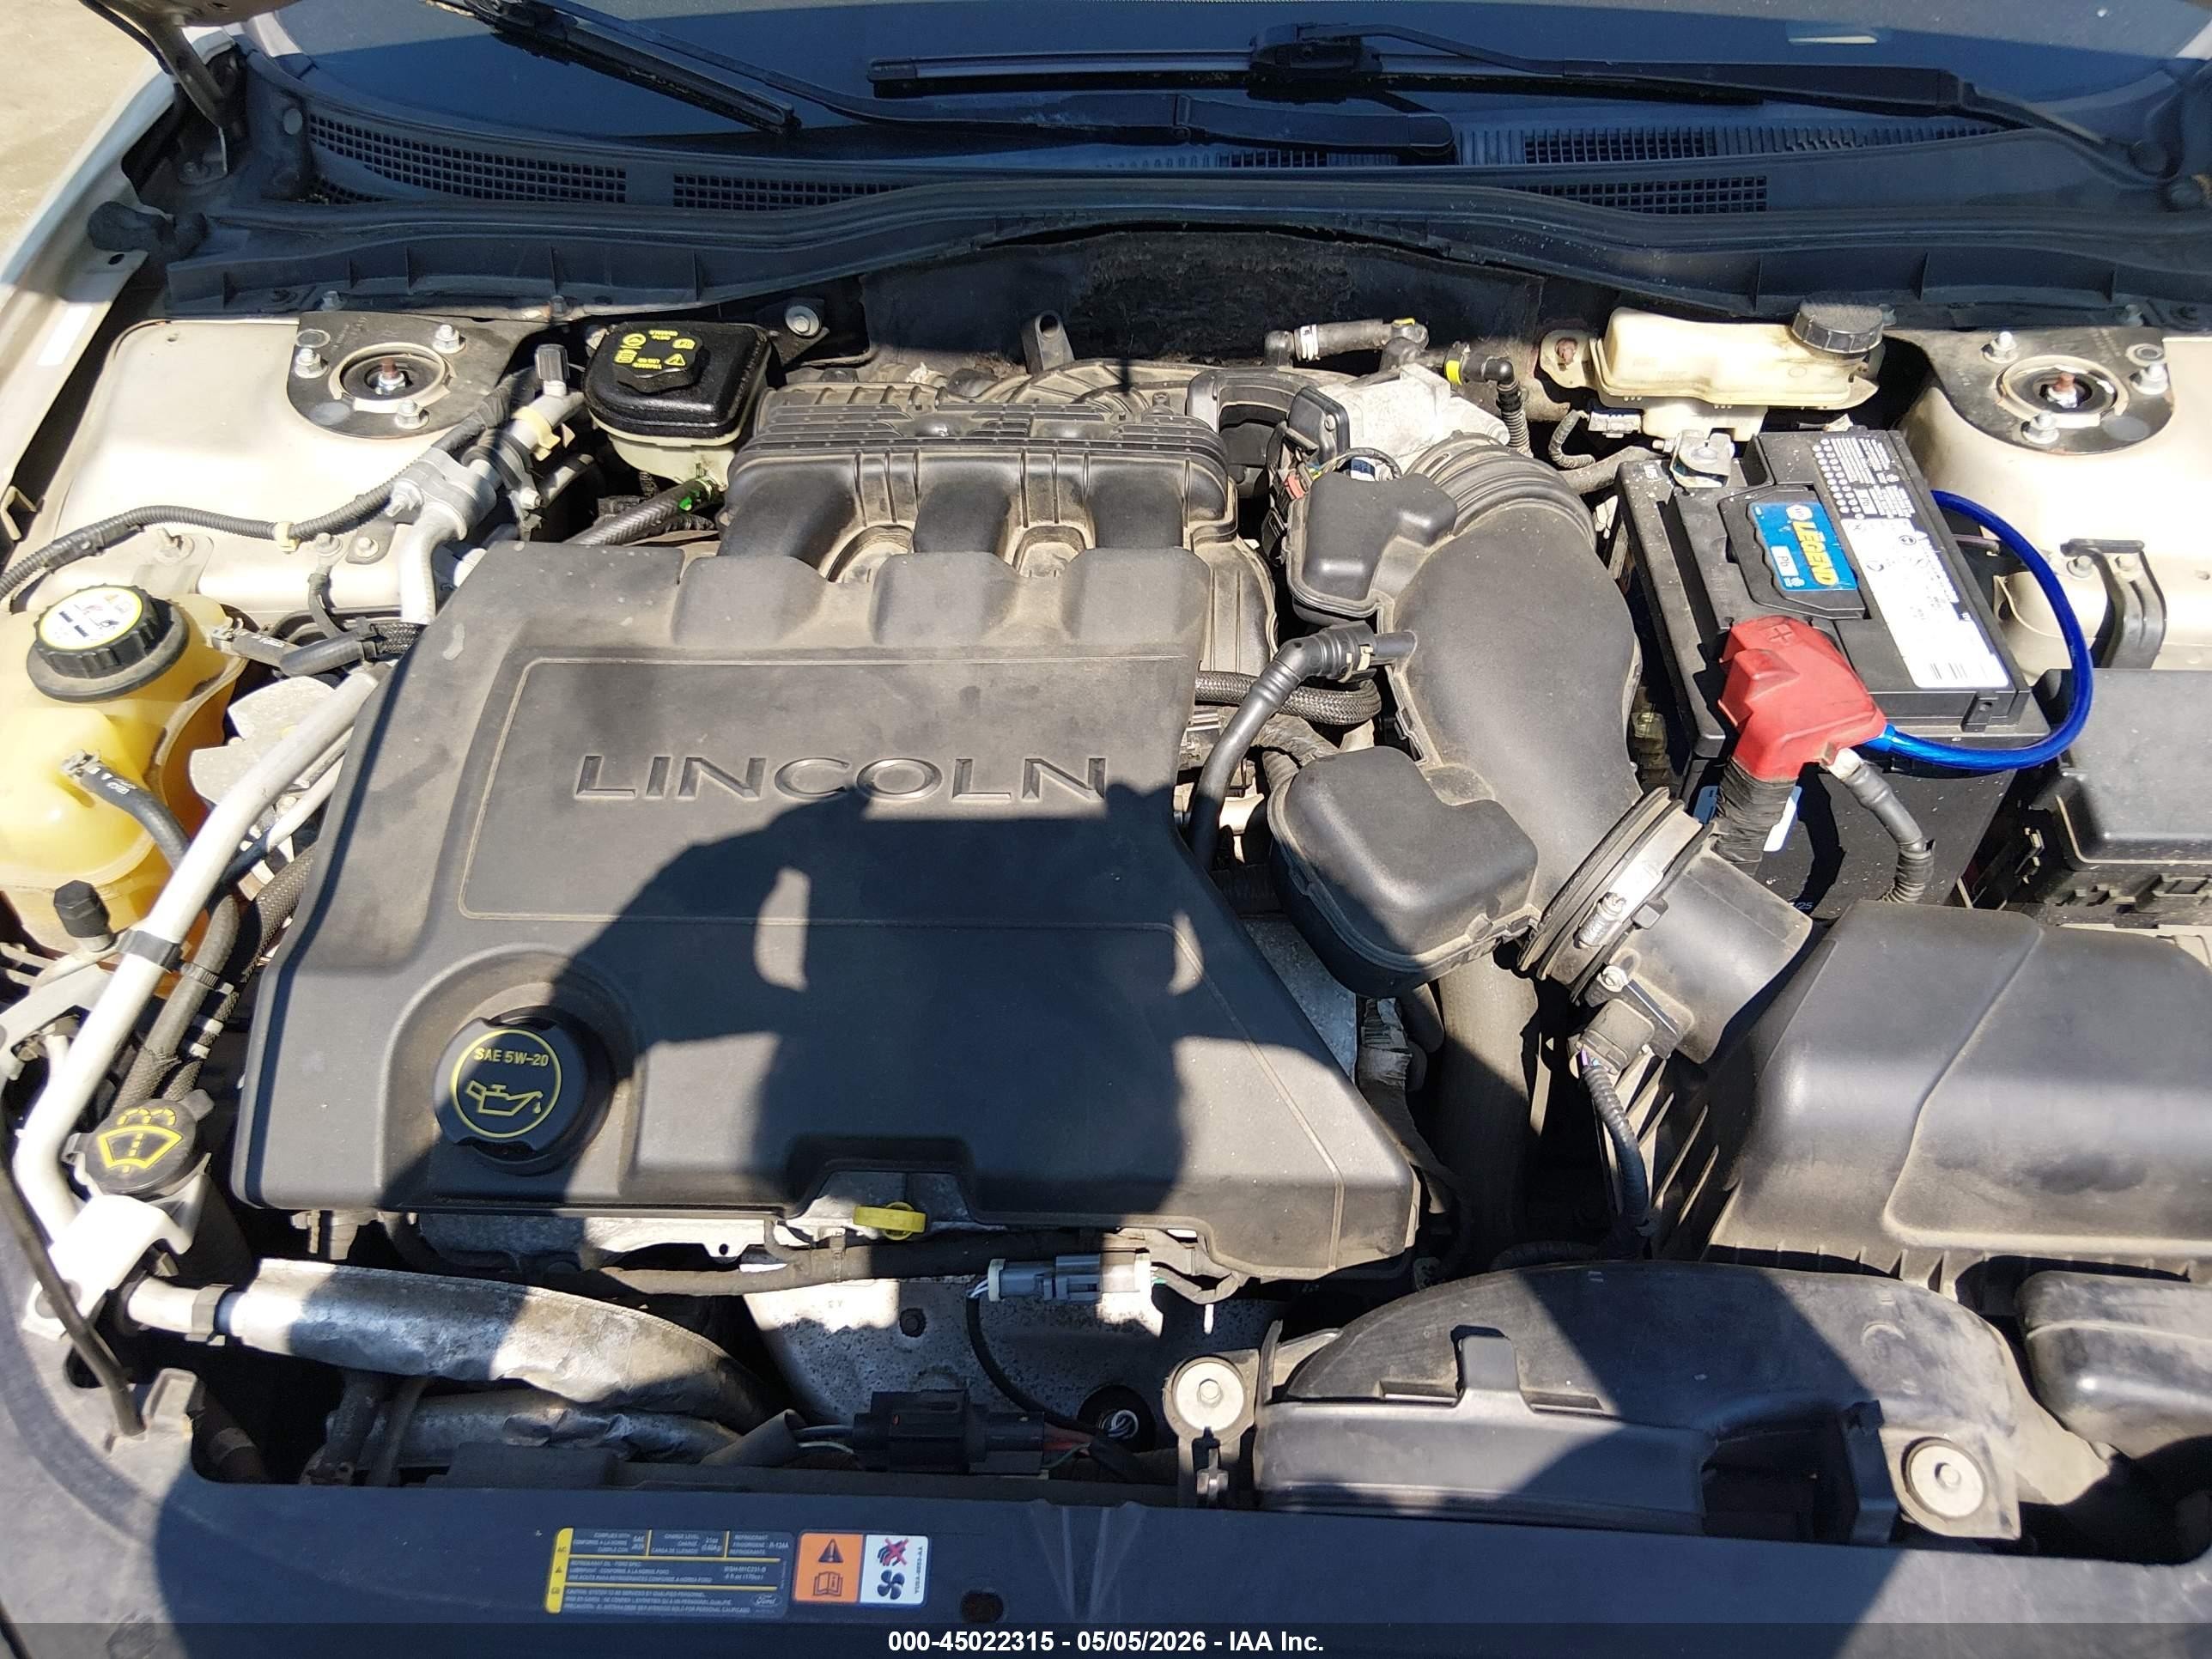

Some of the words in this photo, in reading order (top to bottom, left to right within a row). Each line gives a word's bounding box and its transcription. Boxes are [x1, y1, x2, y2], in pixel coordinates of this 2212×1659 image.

[1778, 556, 1790, 567] Pb
[1792, 520, 1839, 586] LEGEND
[575, 754, 1108, 801] LINCOLN
[473, 1048, 501, 1061] SAE
[505, 1051, 549, 1066] 5W-20
